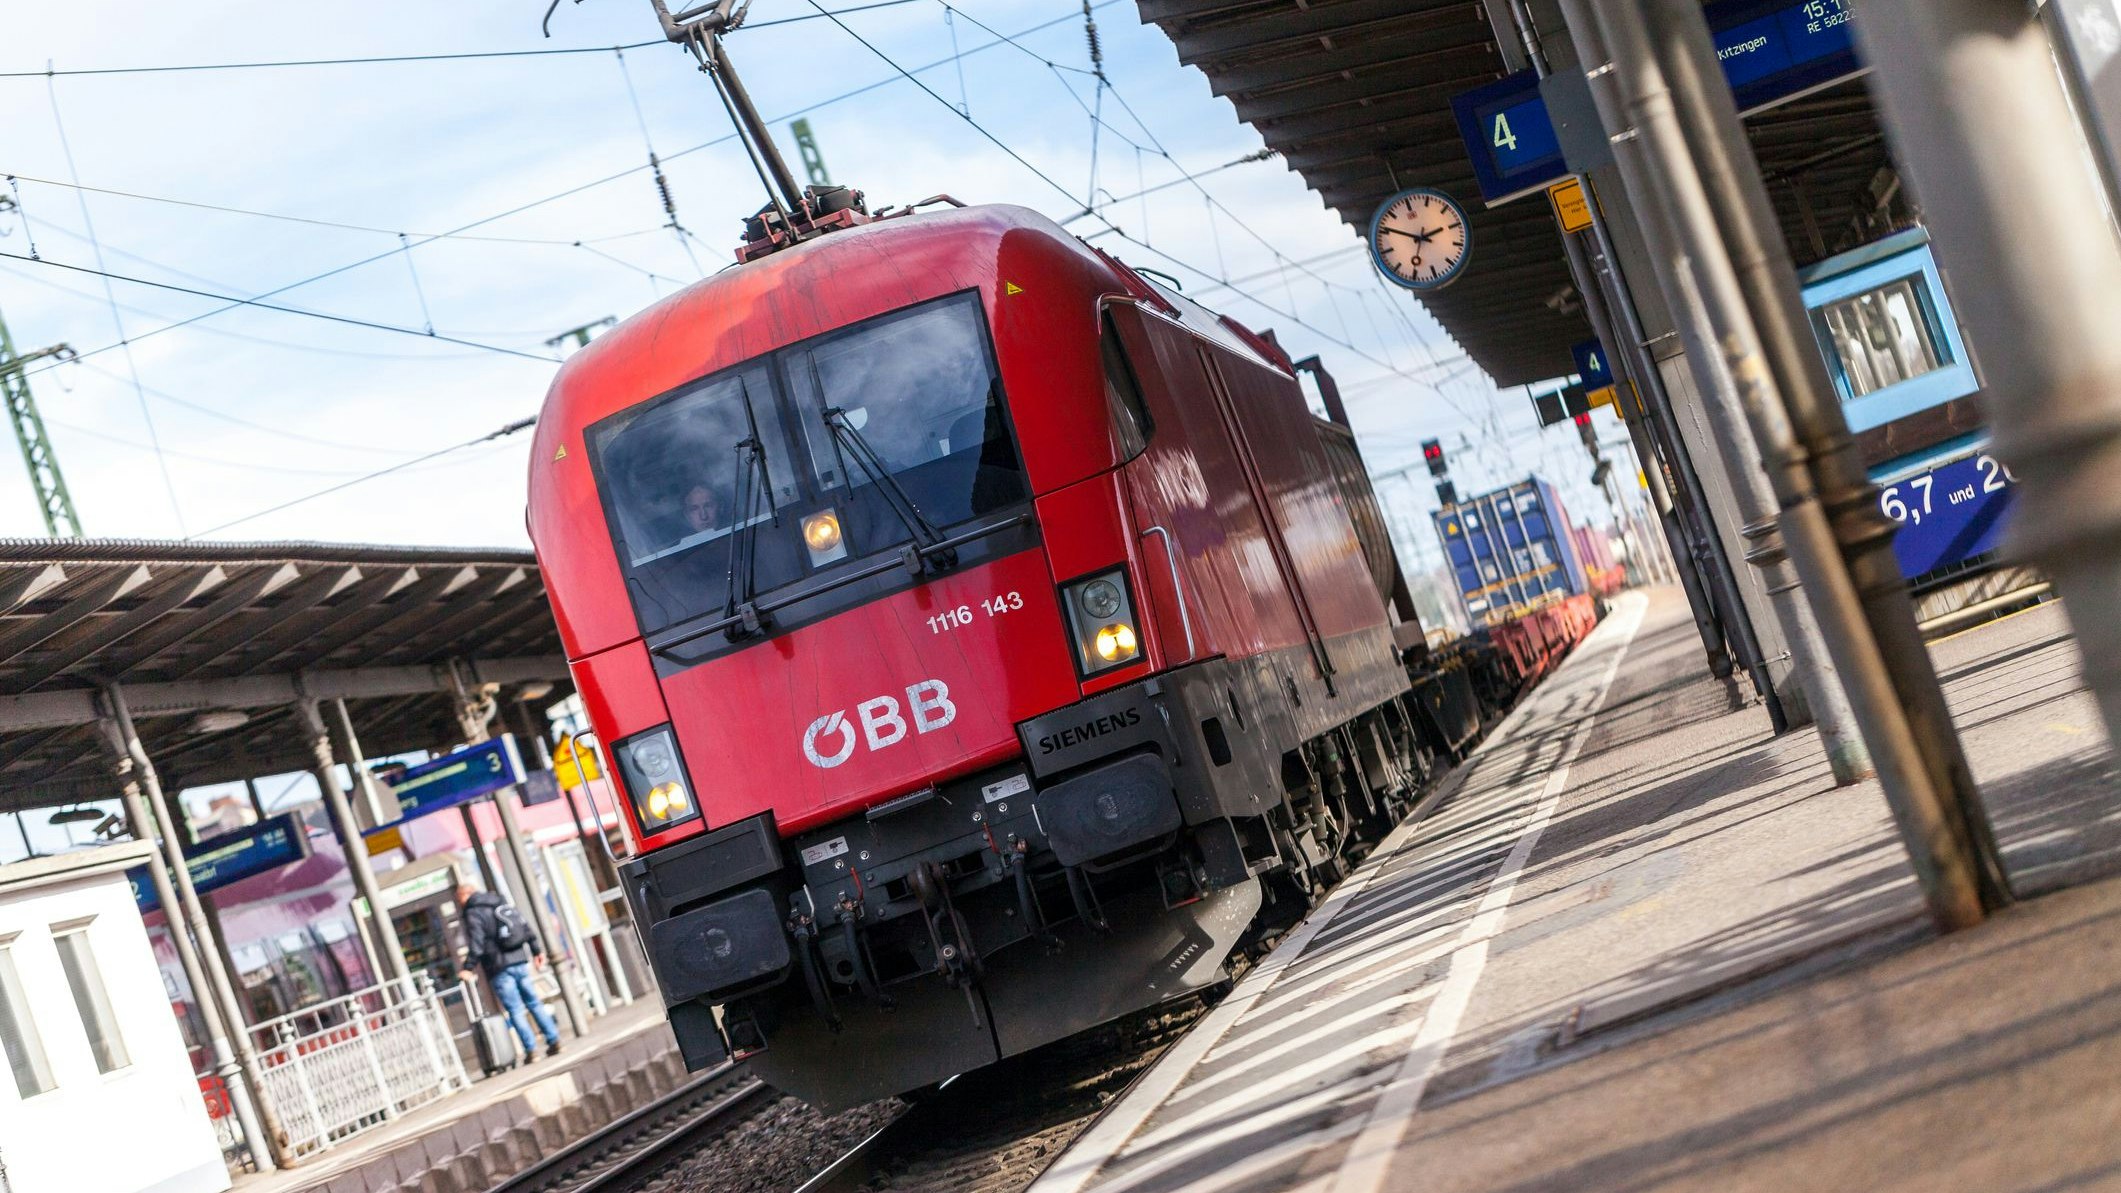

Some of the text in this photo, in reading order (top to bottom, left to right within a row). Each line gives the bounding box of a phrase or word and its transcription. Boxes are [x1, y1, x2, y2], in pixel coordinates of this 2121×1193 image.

[1803, 0, 1851, 19] 15:1
[1807, 20, 1822, 34] RE
[1717, 36, 1767, 60] Kitzingen
[1493, 113, 1517, 150] 4
[1589, 352, 1601, 372] 4
[1881, 475, 1934, 526] 6,7
[1948, 484, 1976, 505] und
[926, 591, 1025, 635] 1116 143
[803, 679, 958, 769] ÖBB
[1039, 707, 1142, 755] SIEMENS
[486, 752, 502, 773] 3
